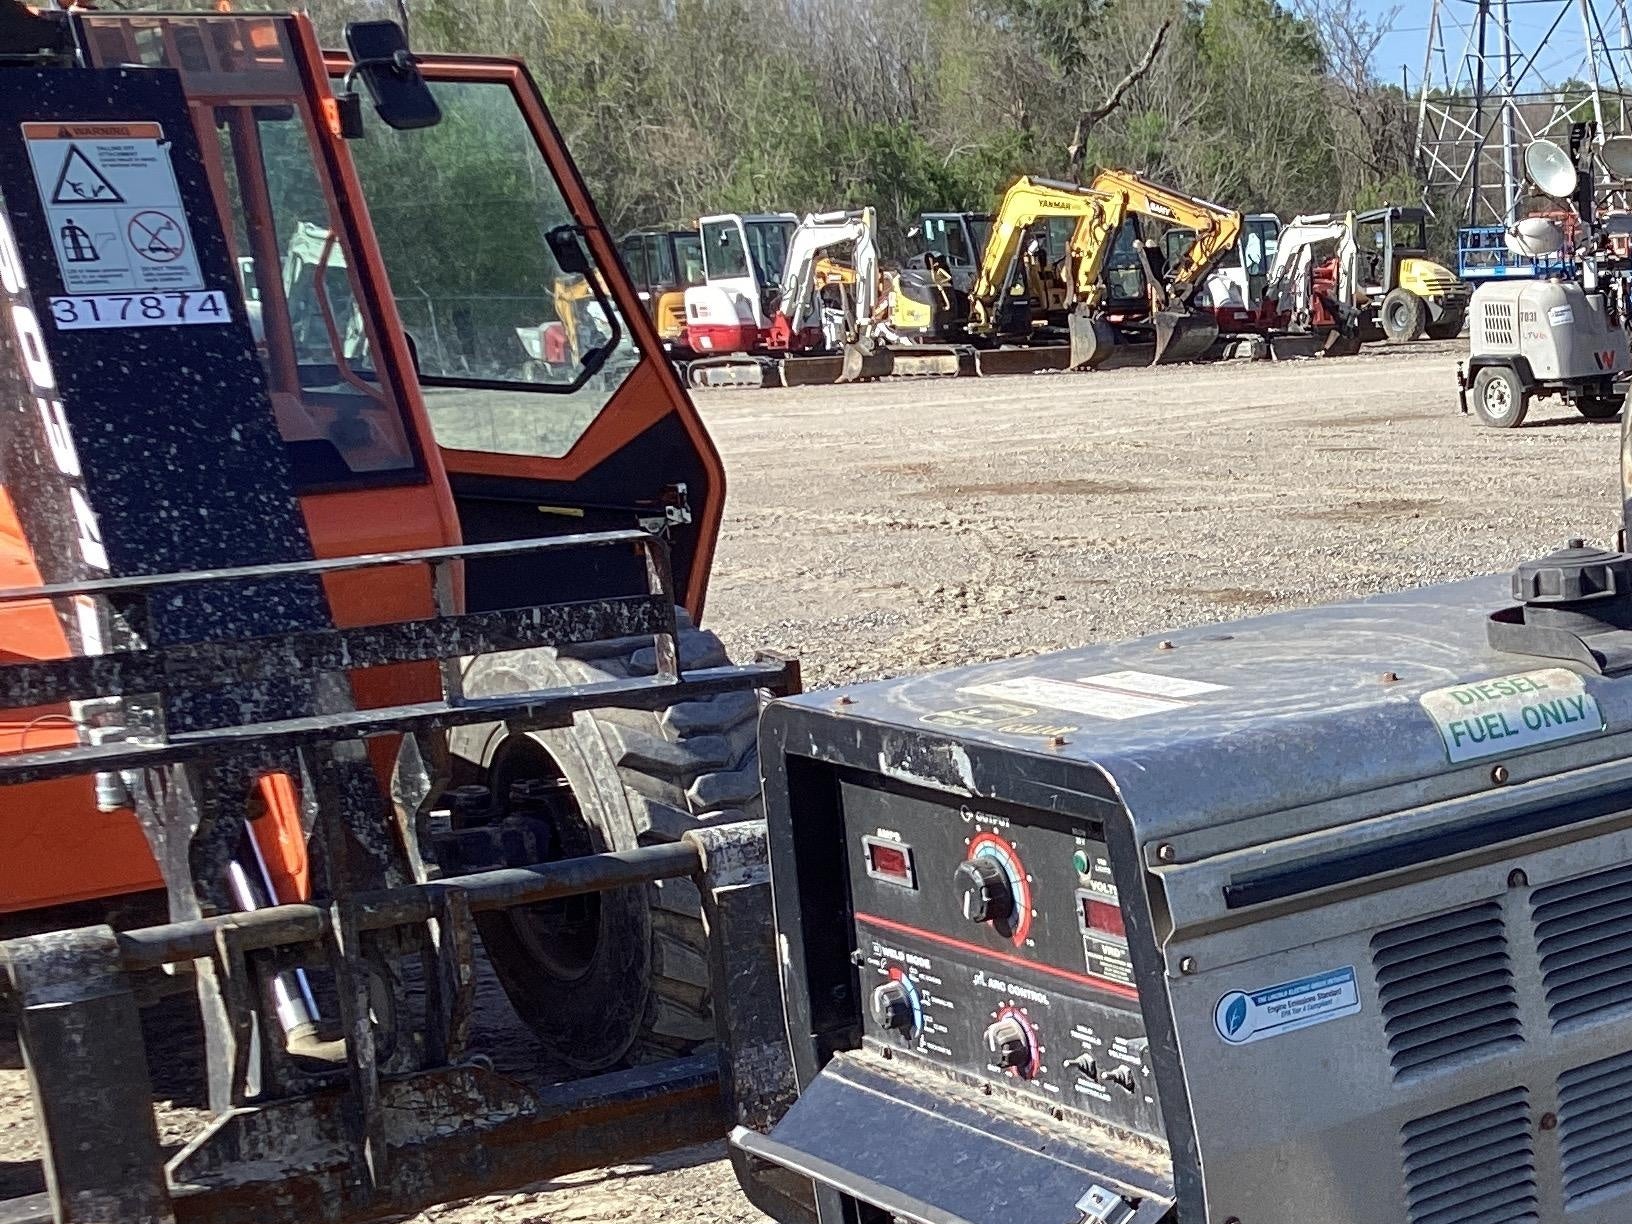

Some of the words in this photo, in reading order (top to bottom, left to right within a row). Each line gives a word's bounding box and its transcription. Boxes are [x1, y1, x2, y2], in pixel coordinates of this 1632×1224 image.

[52, 293, 223, 323] 317874
[1450, 676, 1548, 706] DIESEL
[1449, 712, 1519, 748] FUEL
[1521, 694, 1586, 731] ONLY
[1267, 1001, 1287, 1014] Engine
[1317, 987, 1342, 1000] Standard
